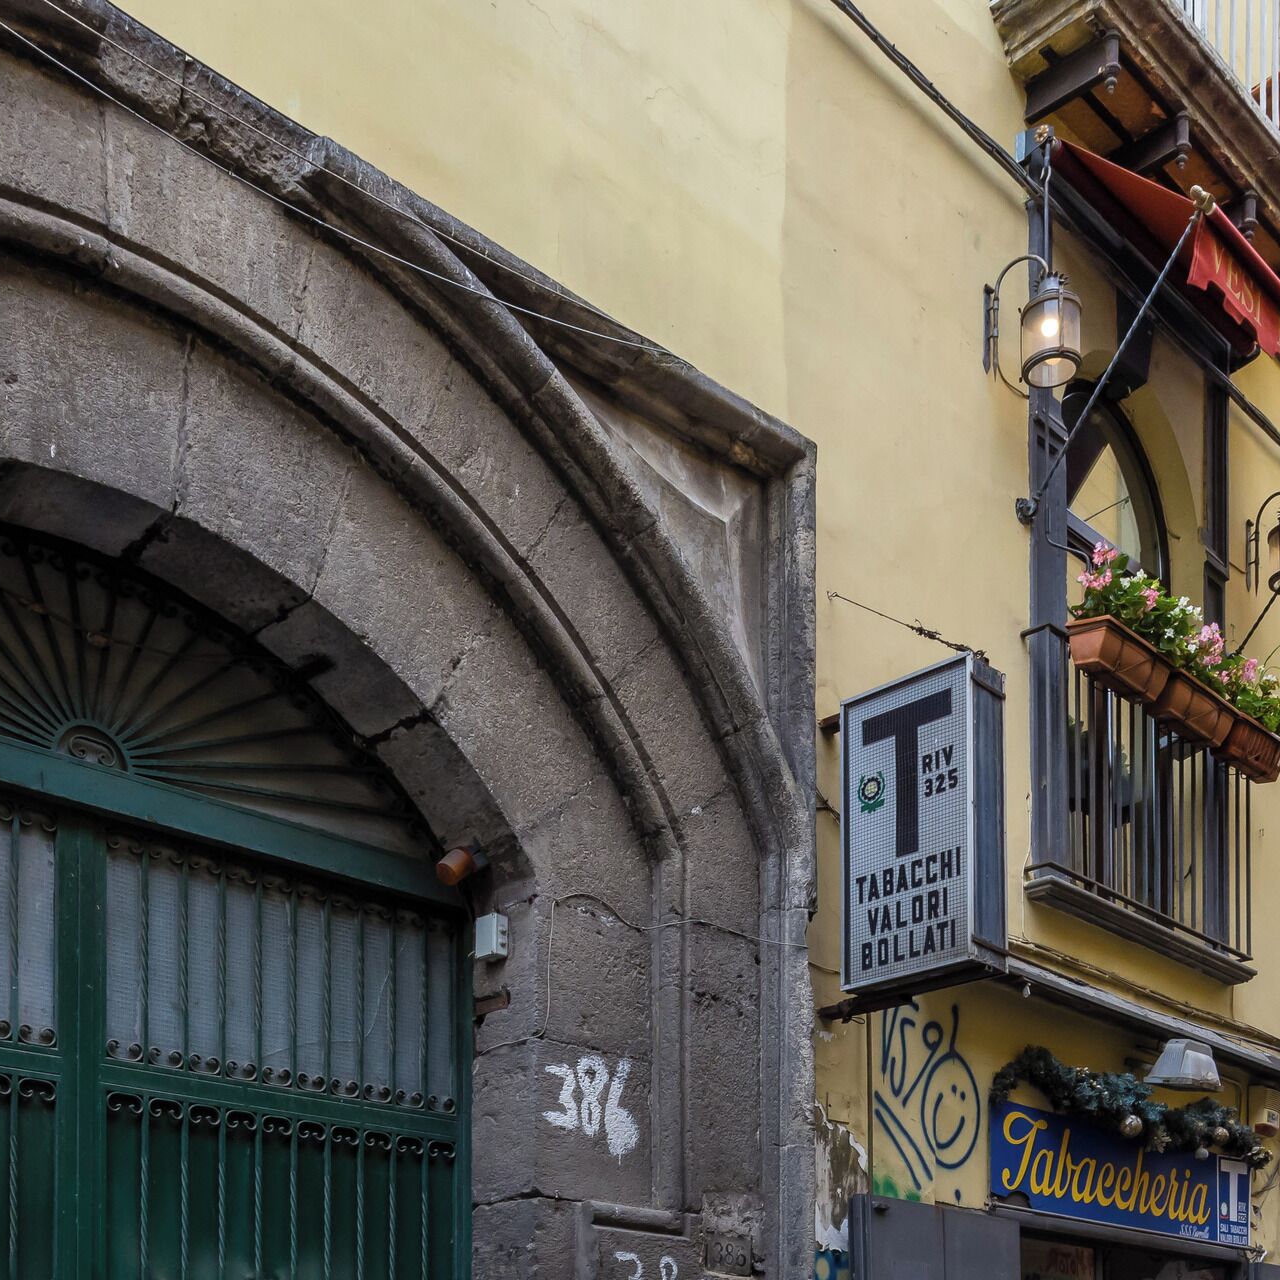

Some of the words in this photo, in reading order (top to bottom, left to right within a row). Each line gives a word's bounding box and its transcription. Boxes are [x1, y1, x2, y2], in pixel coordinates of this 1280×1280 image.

[862, 687, 952, 857] T
[922, 745, 954, 774] RIV
[923, 768, 958, 797] 325
[856, 847, 961, 905] TABACCHI
[868, 887, 948, 936] VALORI
[861, 919, 956, 971] BOLLATI
[541, 1054, 640, 1158] 386
[1001, 1111, 1211, 1225] Tabaccheria
[1221, 1160, 1248, 1222] T
